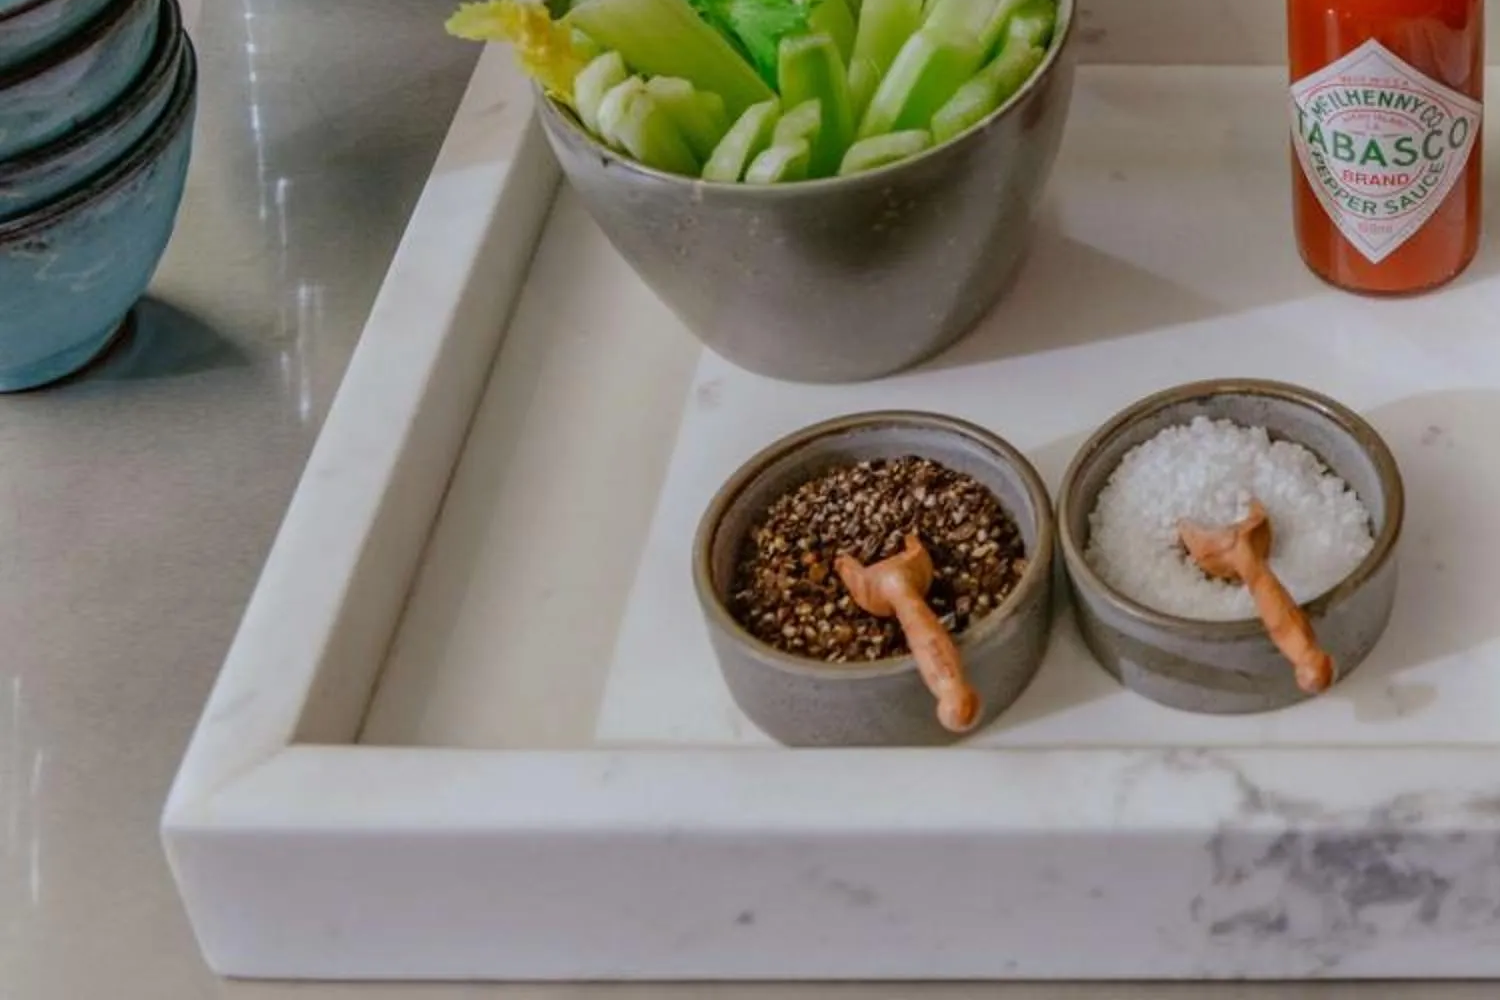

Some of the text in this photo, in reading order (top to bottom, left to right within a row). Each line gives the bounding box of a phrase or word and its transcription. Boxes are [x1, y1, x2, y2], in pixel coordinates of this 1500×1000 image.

[1311, 150, 1445, 215] PEPPER SAUCE
[1343, 169, 1410, 187] BRAND
